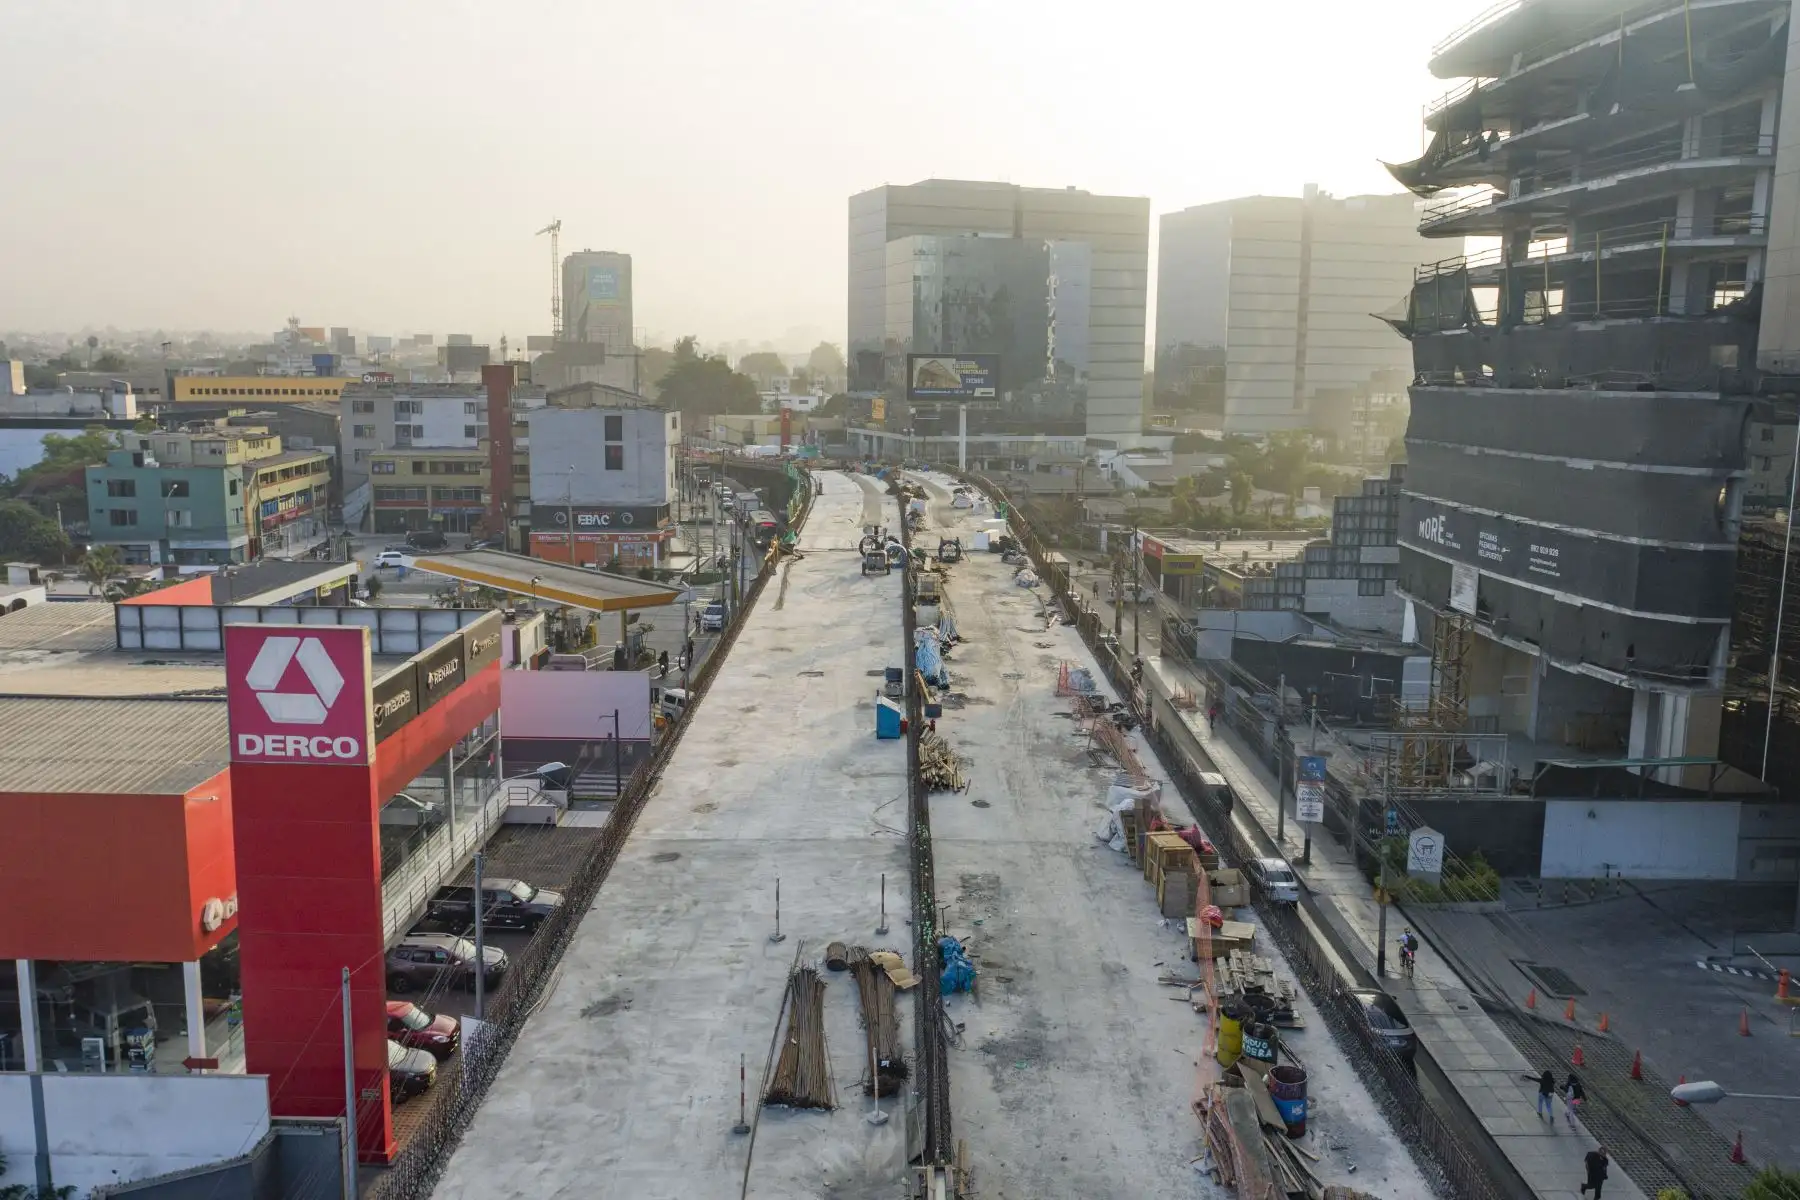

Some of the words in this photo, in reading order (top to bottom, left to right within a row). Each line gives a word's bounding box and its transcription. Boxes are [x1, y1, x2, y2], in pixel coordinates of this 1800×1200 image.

[1418, 515, 1446, 544] MORE
[434, 658, 459, 685] RENAULT
[238, 733, 360, 758] DERCO
